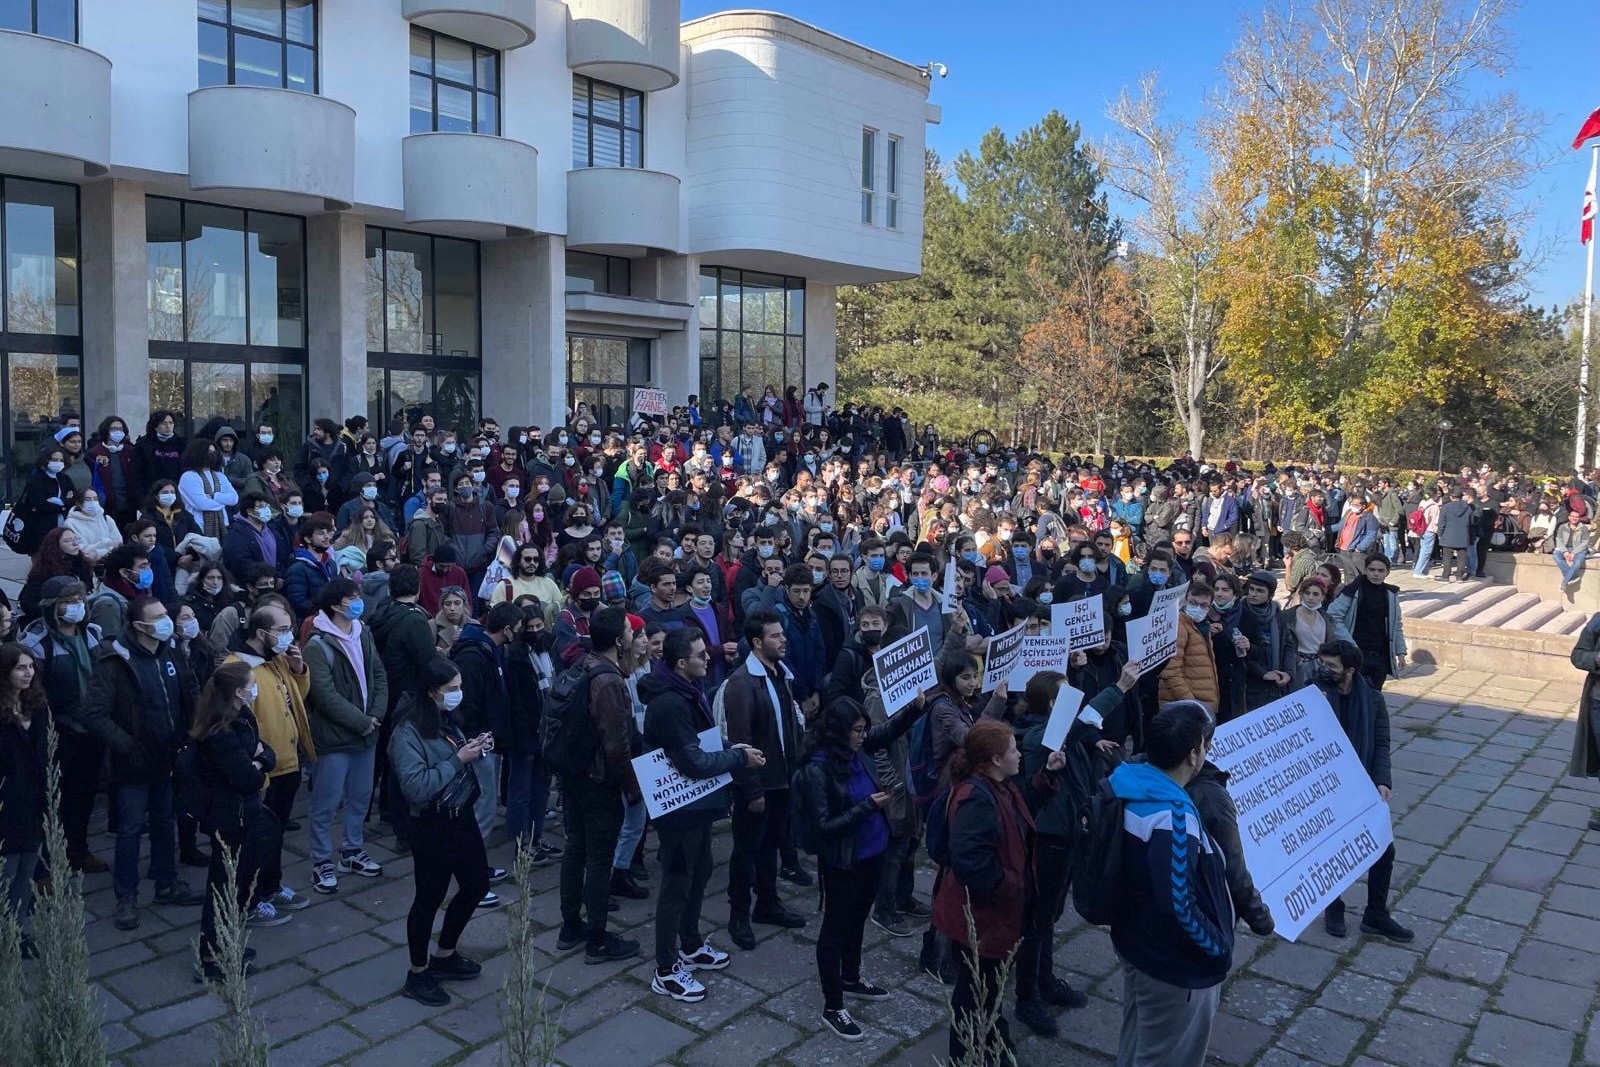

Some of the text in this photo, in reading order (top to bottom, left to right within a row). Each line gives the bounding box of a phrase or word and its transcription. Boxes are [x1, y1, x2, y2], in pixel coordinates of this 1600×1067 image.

[635, 400, 664, 412] HANE
[1065, 611, 1097, 626] GENÇLİK
[1075, 601, 1089, 614] İŞÇİ
[1070, 624, 1093, 637] EL ELE
[1151, 612, 1167, 628] İŞÇİ
[1025, 637, 1066, 647] YEMEKHANE
[1141, 621, 1173, 645] GENÇLİK
[883, 635, 924, 668] NİTELİKLİ
[1020, 647, 1067, 658] İŞÇİYE ZULÜM
[1145, 636, 1168, 656] EL ELE
[881, 650, 932, 688] YEMEKHANE
[1024, 657, 1063, 668] ÖĞRENCİYE
[888, 668, 932, 703] İSTİYORUZ!
[1208, 701, 1308, 762] SAĞLIKLI VE ULAŞILABİLİR
[1265, 734, 1304, 767] HAKKIMIZ
[1300, 728, 1315, 747] VE
[653, 780, 690, 801] ZULÜM
[1233, 741, 1344, 817] EKHANE İŞÇİLERİNİN İNSANCA
[662, 777, 721, 811] YEMEKHANE
[1248, 771, 1342, 847] ÇALIŞMA KOŞULLARI İÇİN
[1281, 806, 1336, 856] BİR ARADAYIZ!
[1284, 824, 1379, 922] ODTÜ ÖĞRENCİLERİ
